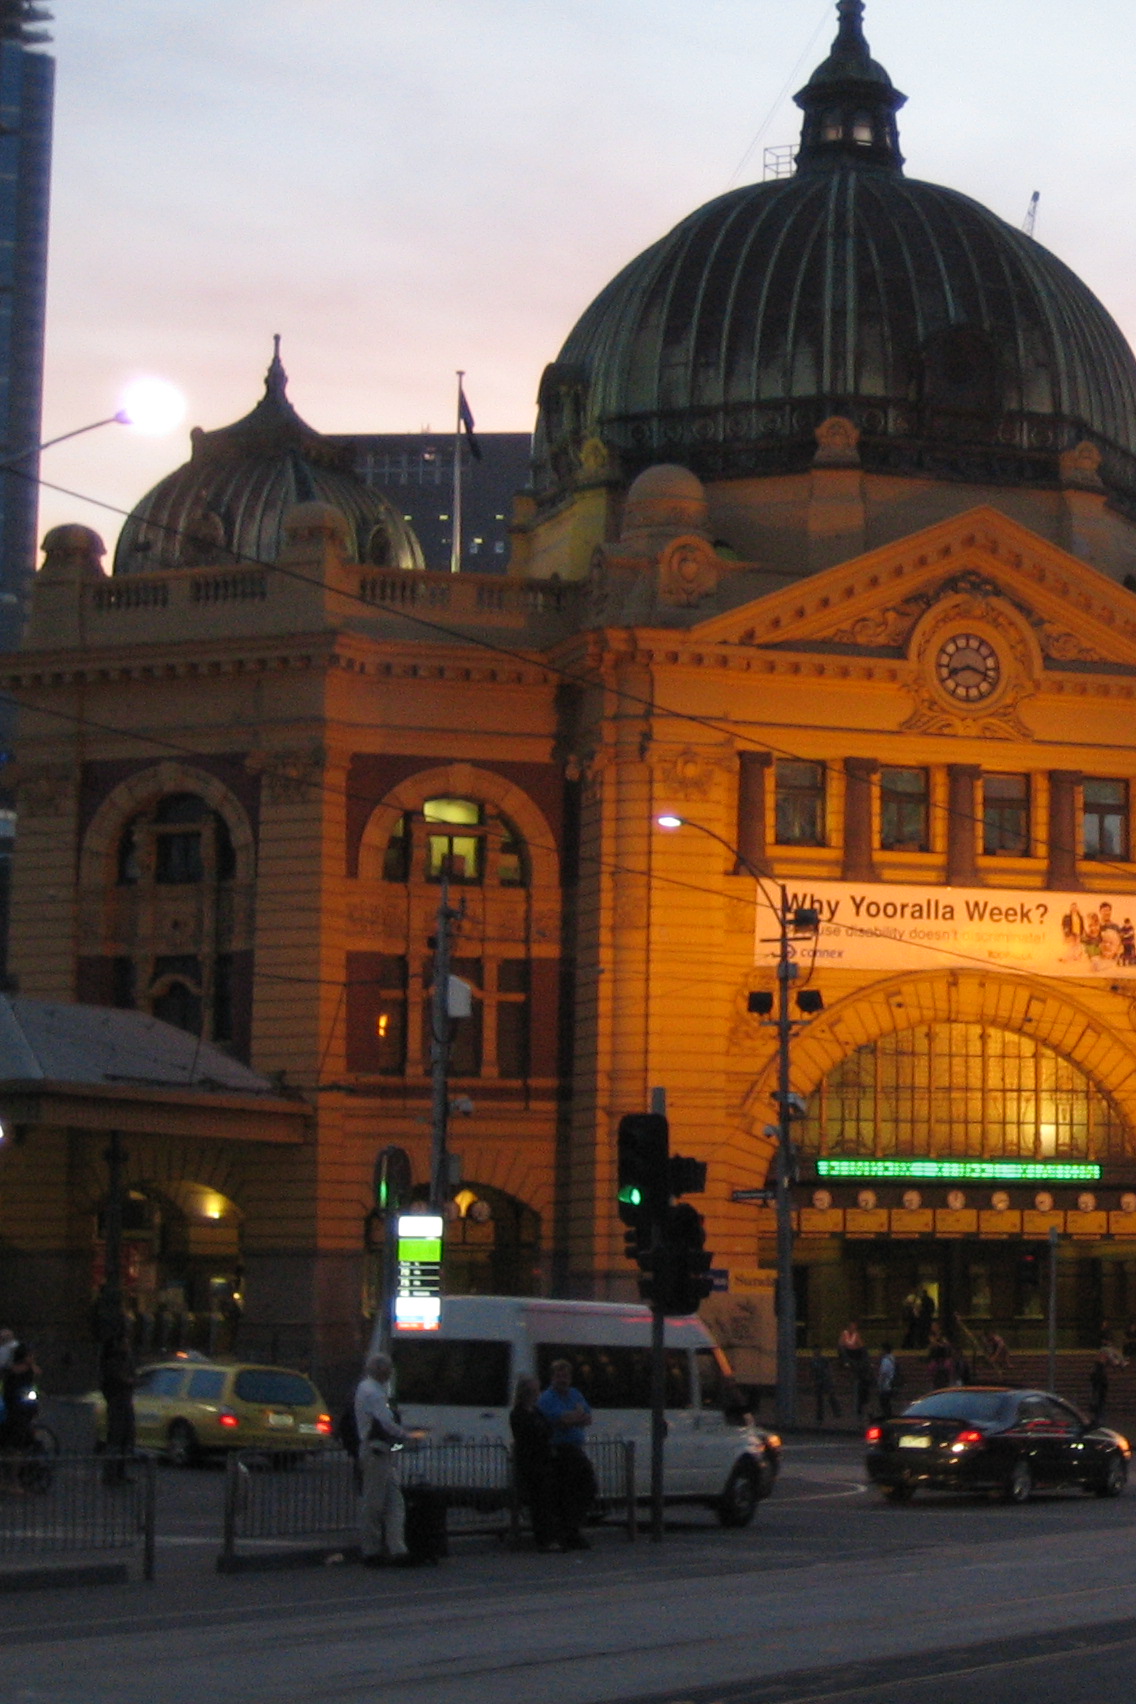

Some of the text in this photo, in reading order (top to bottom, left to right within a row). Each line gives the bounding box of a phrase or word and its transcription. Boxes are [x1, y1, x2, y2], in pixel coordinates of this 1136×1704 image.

[785, 893, 1048, 925] Why Yooralla Week?
